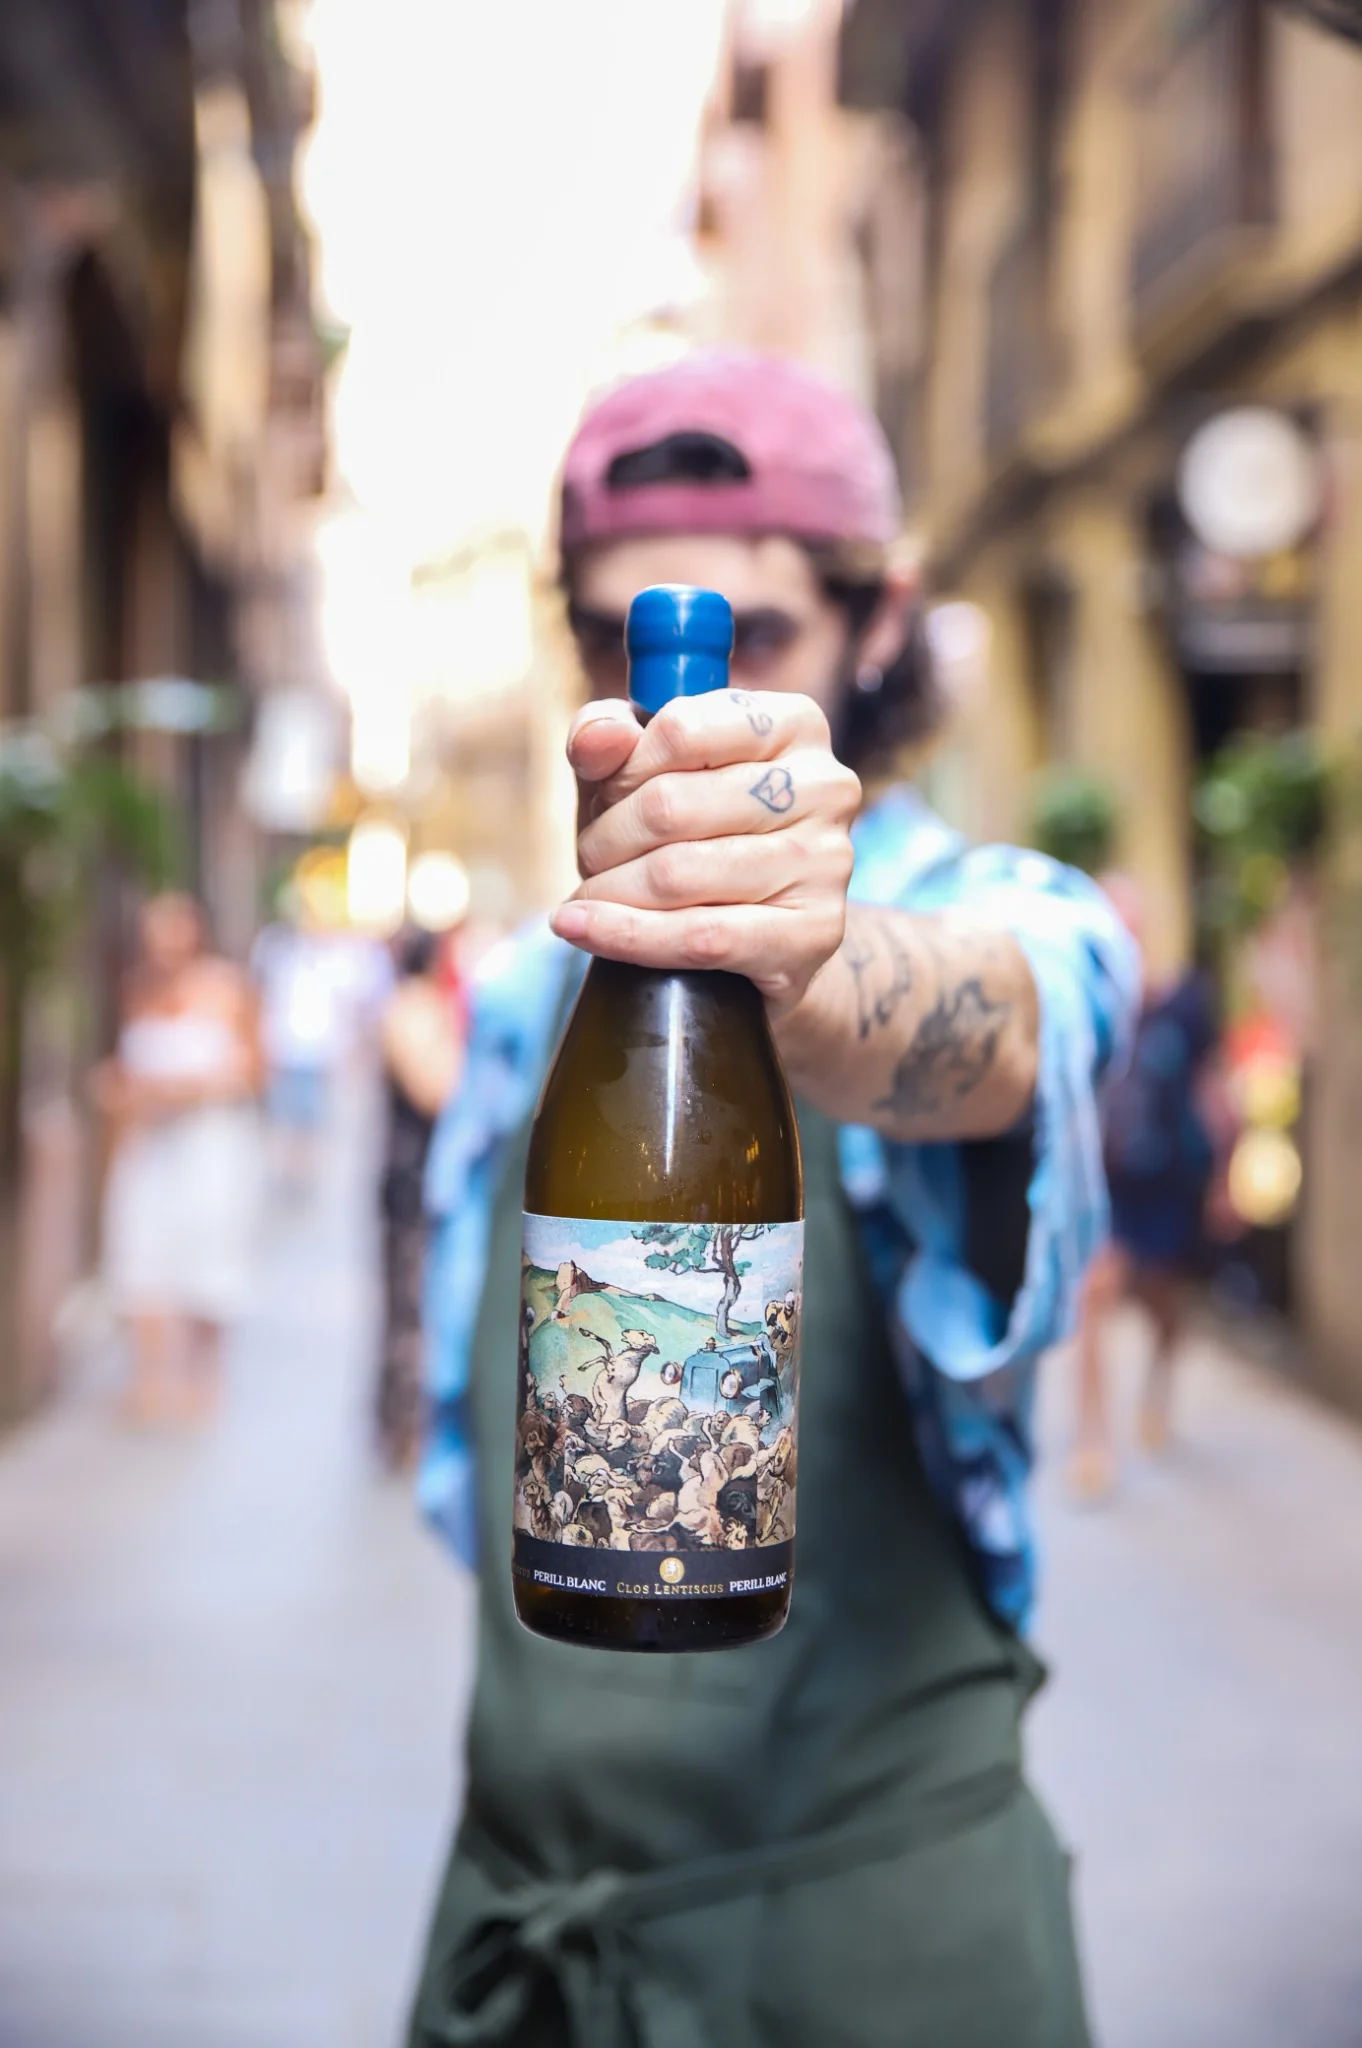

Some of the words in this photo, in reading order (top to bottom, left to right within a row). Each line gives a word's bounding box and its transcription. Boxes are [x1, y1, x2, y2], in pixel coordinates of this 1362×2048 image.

[533, 1569, 565, 1587] PERILL
[566, 1576, 607, 1592] BLANC
[616, 1581, 650, 1595] CLOS
[654, 1583, 724, 1596] LENTISCUS
[729, 1577, 765, 1592] PERILL
[766, 1571, 787, 1588] BLANC
